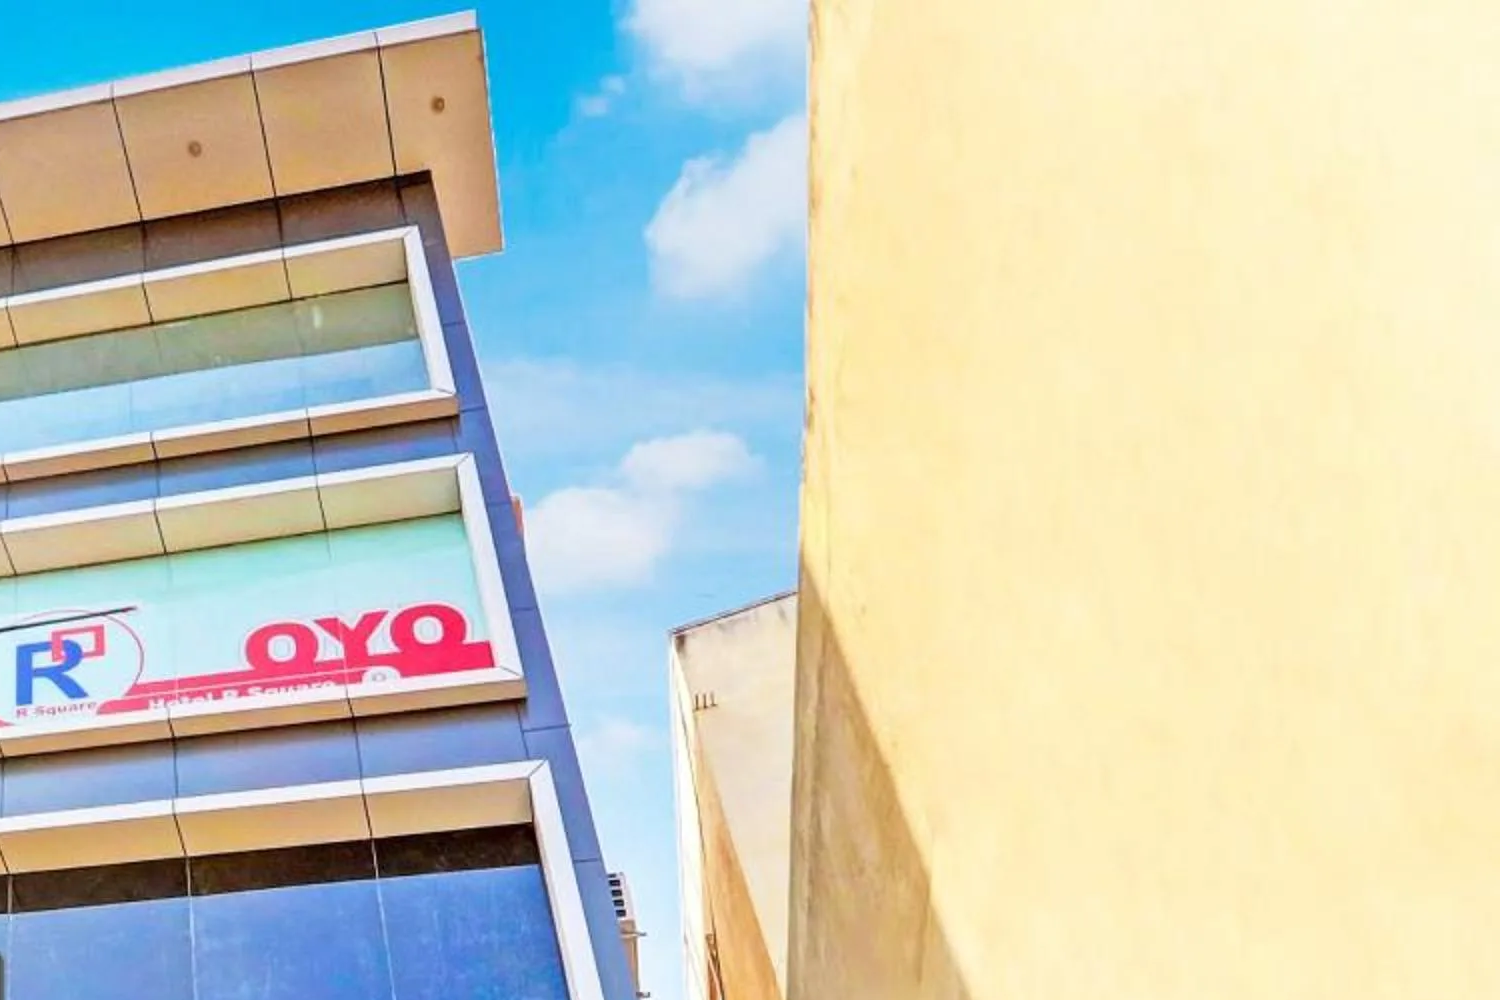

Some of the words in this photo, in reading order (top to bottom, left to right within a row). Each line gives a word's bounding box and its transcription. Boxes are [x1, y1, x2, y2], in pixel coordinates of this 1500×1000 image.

[246, 603, 466, 673] OYO
[16, 707, 28, 718] R
[34, 702, 97, 716] Square
